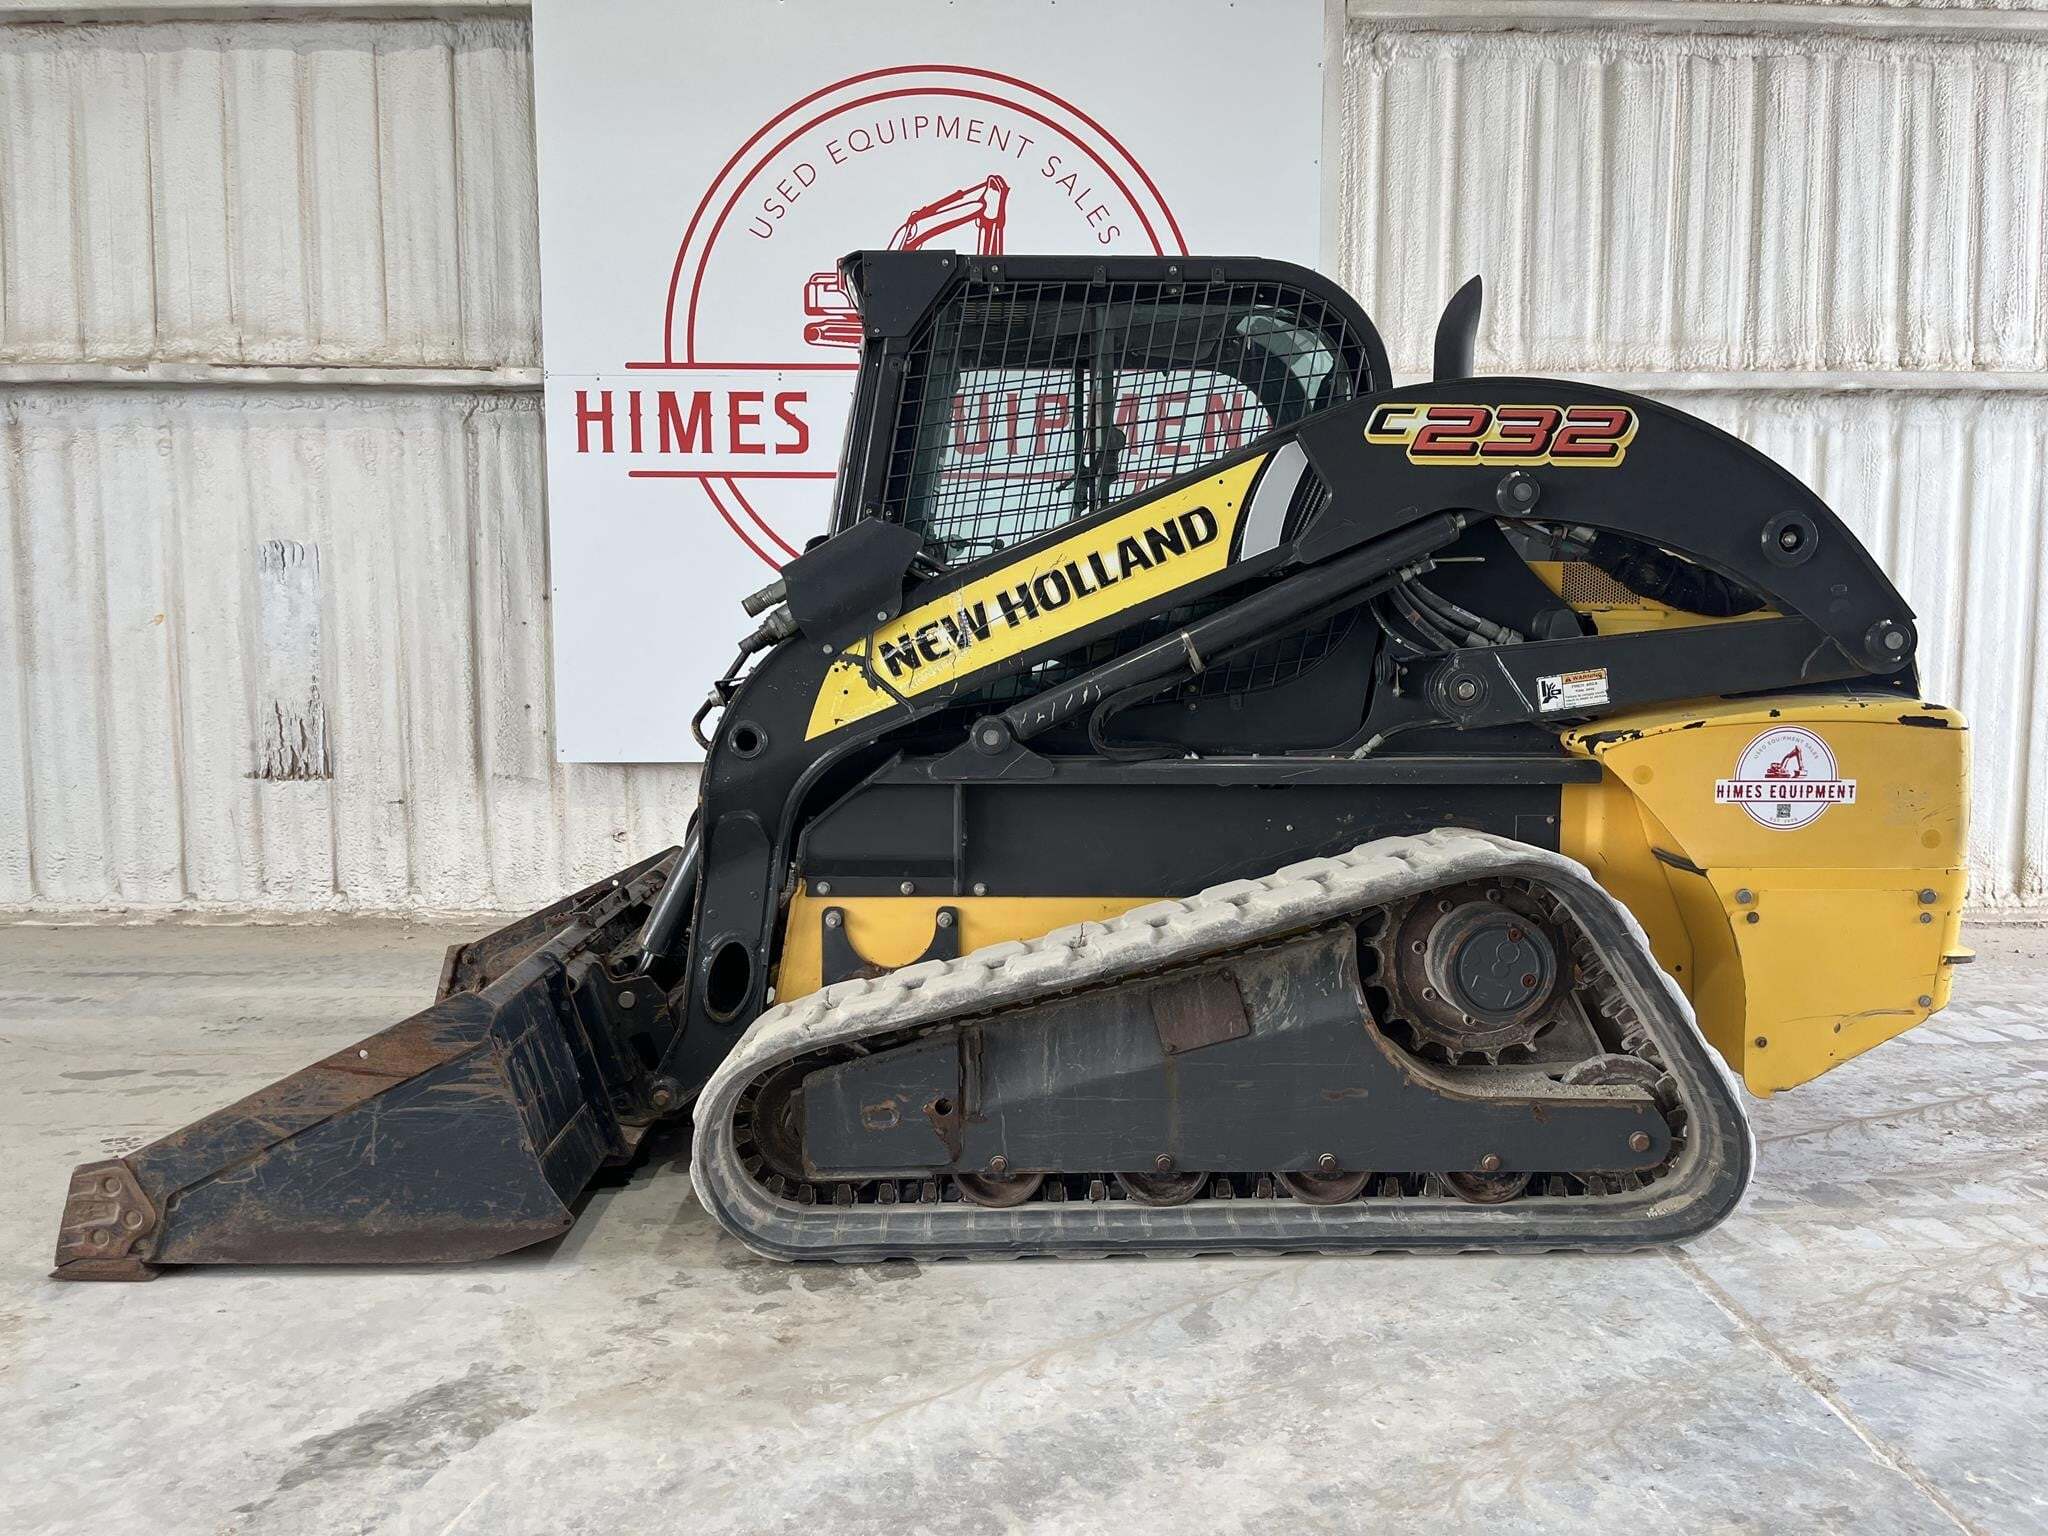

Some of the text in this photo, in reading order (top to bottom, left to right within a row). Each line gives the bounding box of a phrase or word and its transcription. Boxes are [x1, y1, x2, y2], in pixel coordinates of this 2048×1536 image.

[749, 115, 1120, 245] USED EQUIPMENT SALES
[575, 390, 809, 454] HIMES
[878, 505, 1219, 678] NEW HOLLAND
[1716, 784, 1856, 799] HIMES EQUIPMENT
